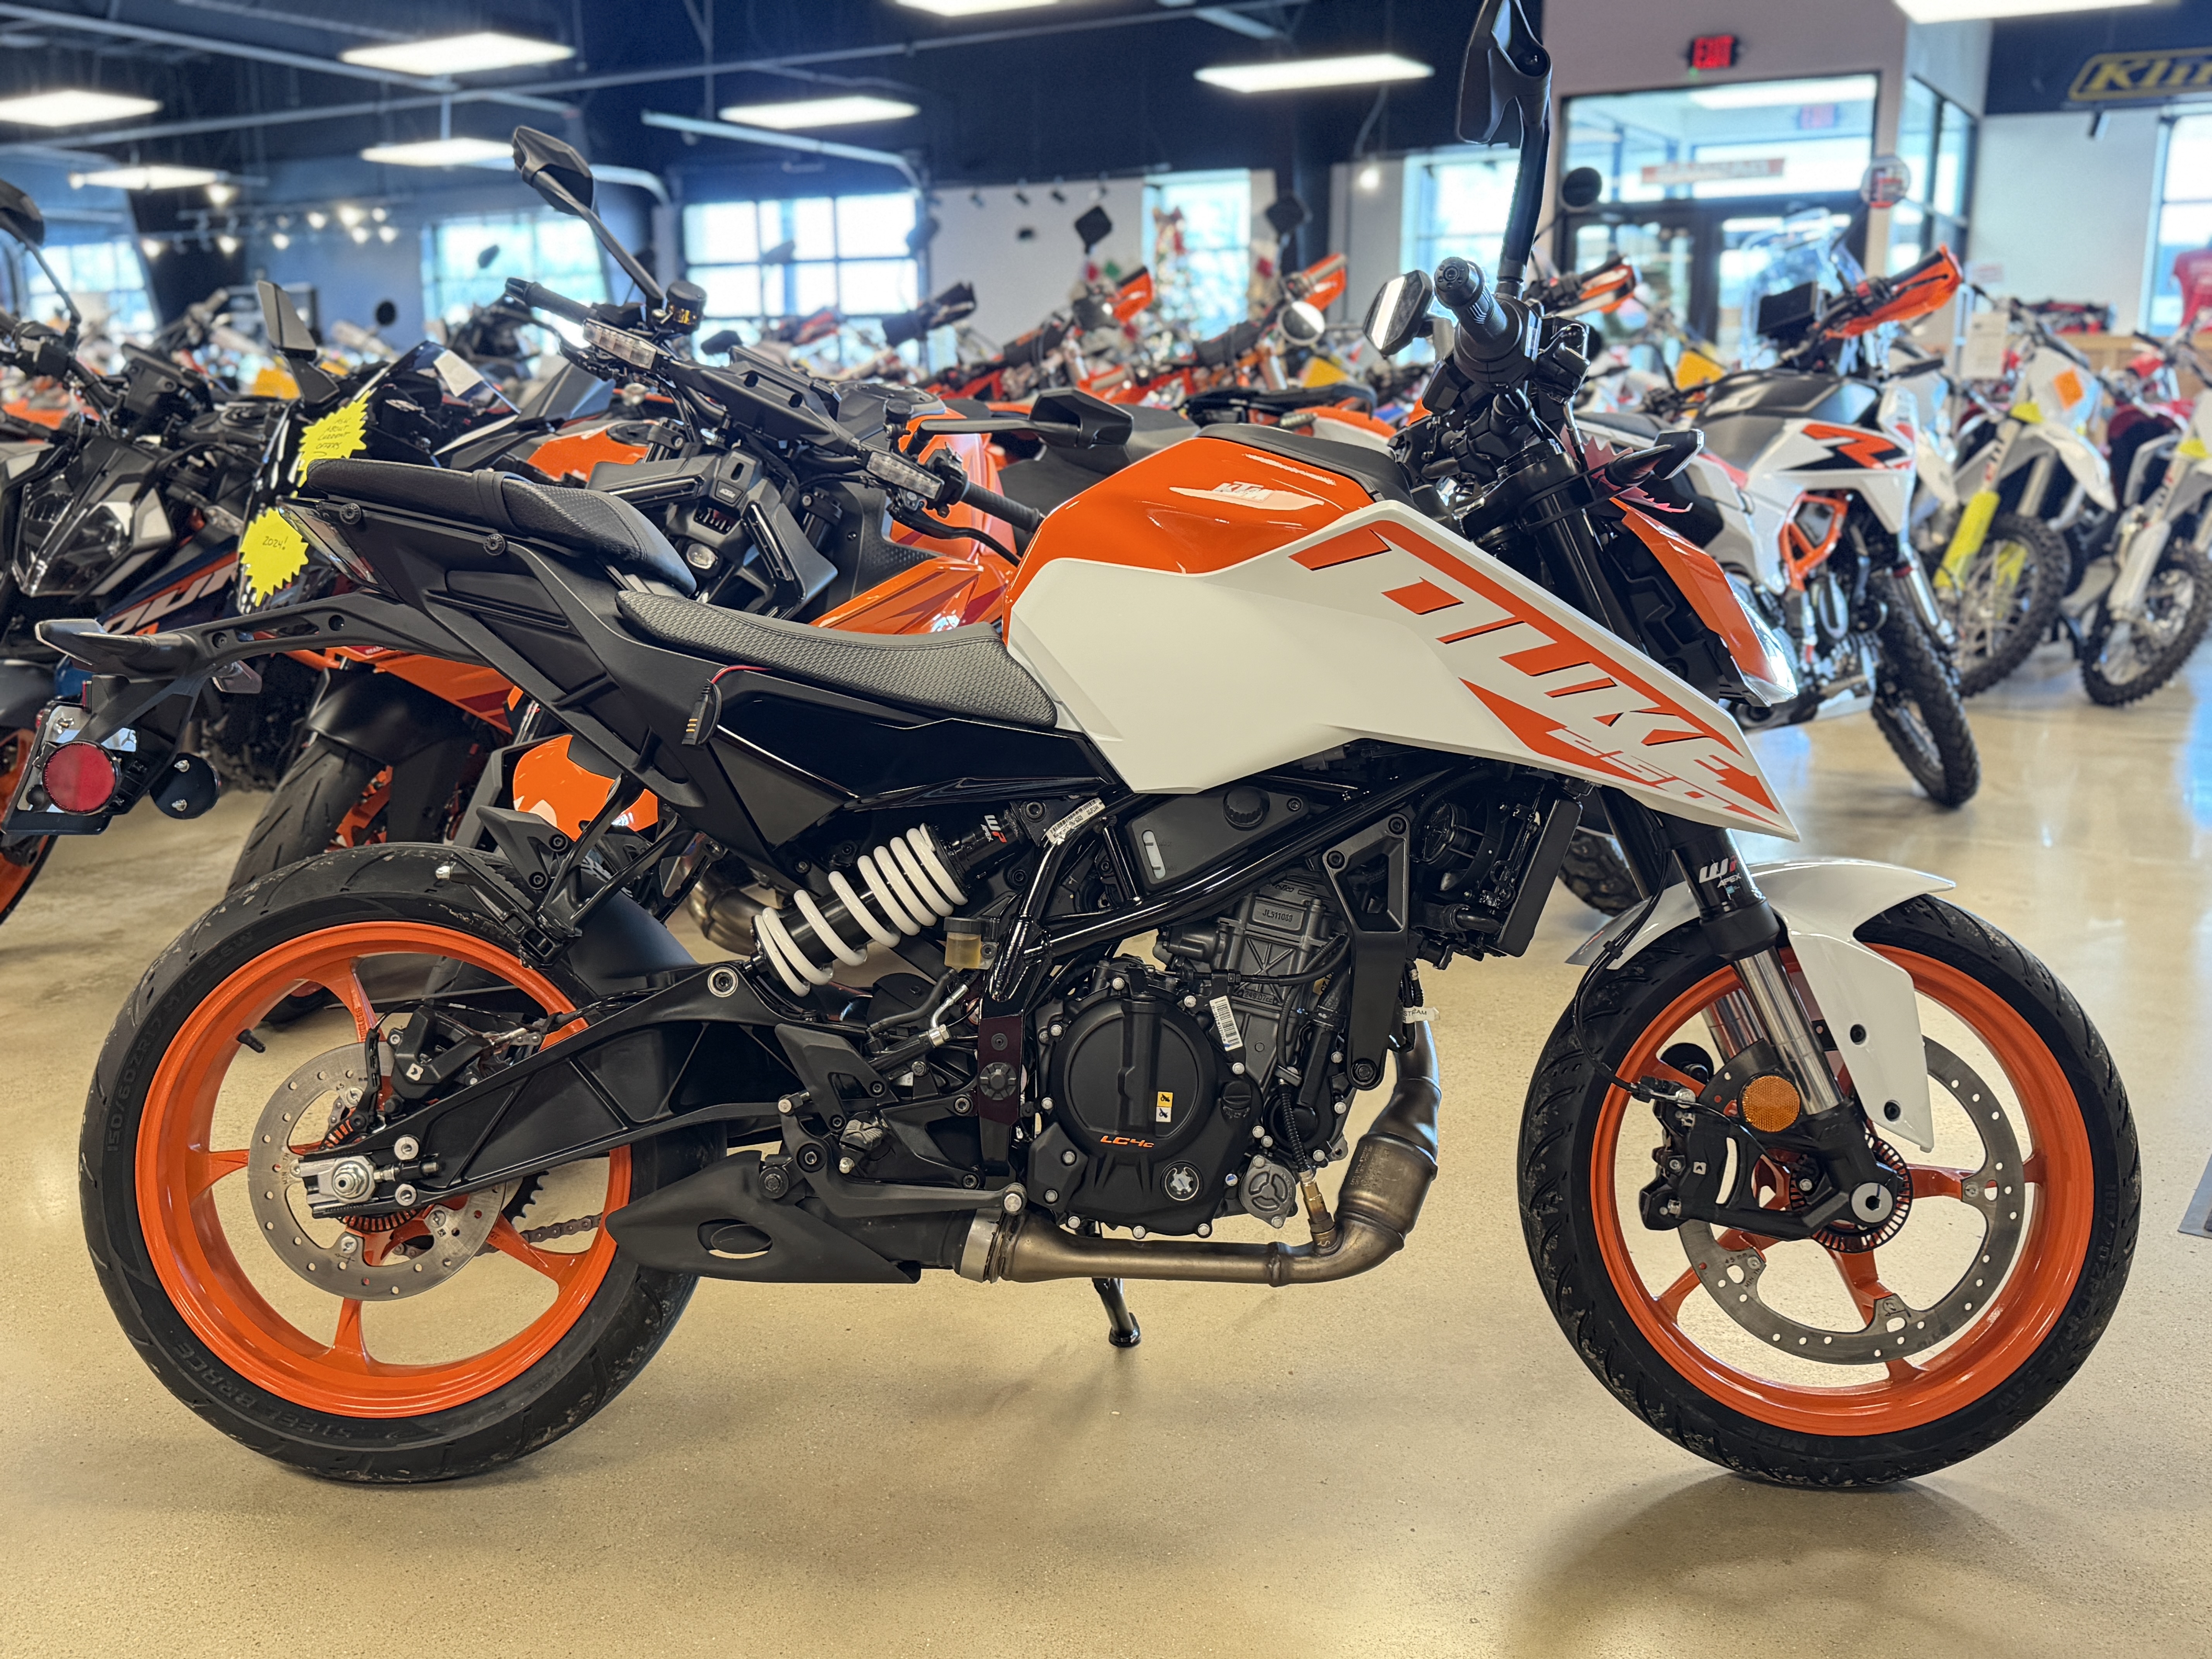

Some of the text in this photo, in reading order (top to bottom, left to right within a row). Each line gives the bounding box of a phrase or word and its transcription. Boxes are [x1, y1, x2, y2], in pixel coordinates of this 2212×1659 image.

[1693, 35, 1734, 69] EXIT
[318, 432, 350, 441] CURRENT
[325, 424, 349, 433] ABOUT
[316, 442, 342, 450] OFFERS
[1212, 480, 1274, 502] KTM
[262, 536, 289, 550] 2024!
[1297, 524, 1768, 794] DUKE
[980, 824, 994, 842] APEX
[984, 814, 1007, 843] WP
[1717, 872, 1741, 888] APEX
[1100, 1134, 1154, 1149] LC4c
[172, 1338, 258, 1411] BRACE
